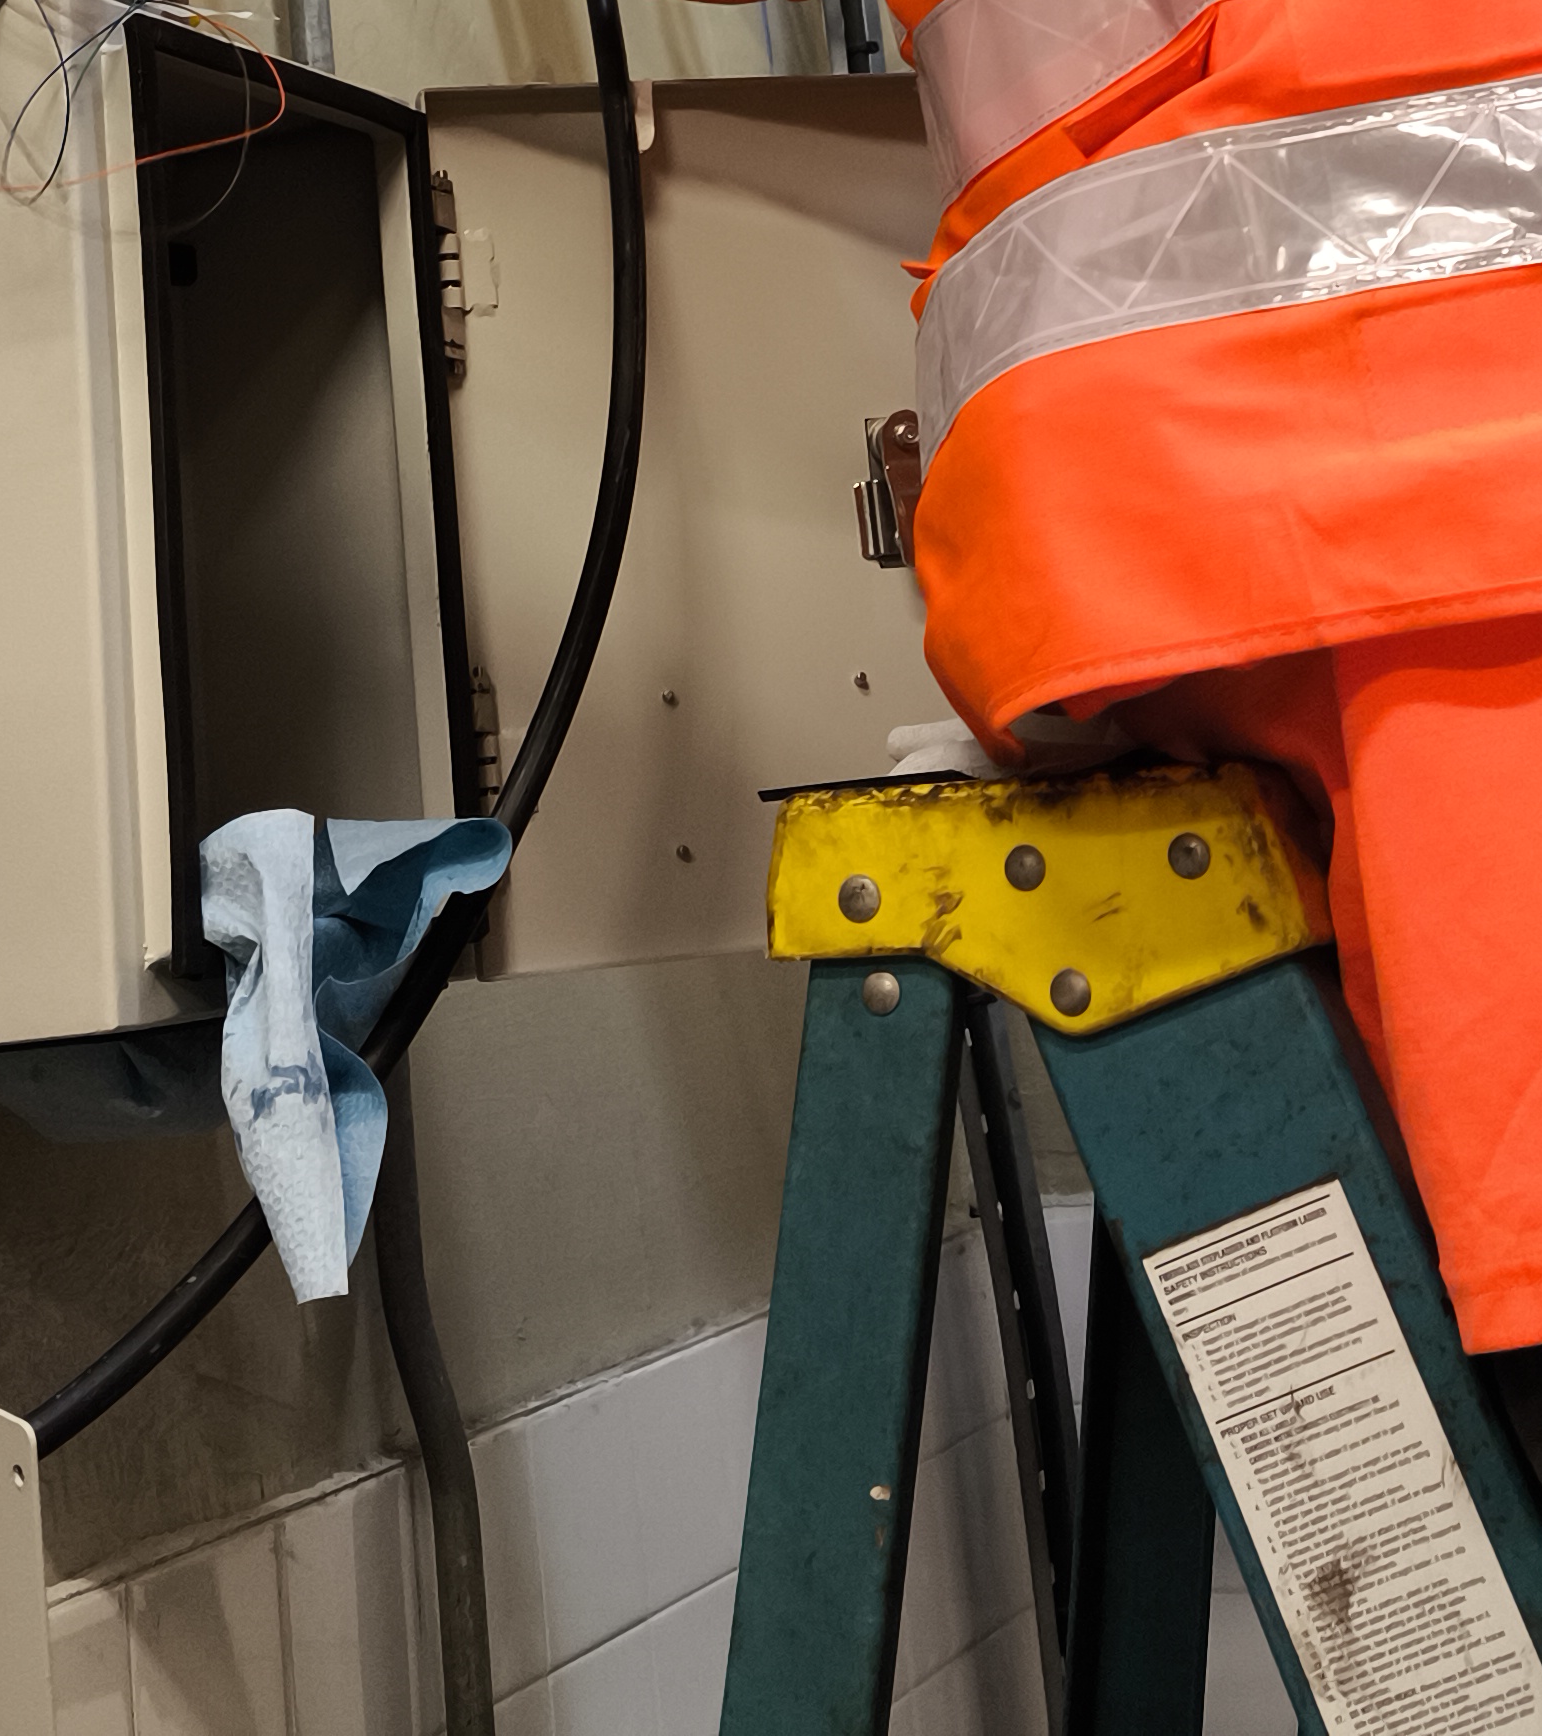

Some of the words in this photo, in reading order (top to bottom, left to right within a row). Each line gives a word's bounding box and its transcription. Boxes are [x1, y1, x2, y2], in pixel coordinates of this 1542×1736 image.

[1163, 1273, 1199, 1296] SAFETY
[1199, 1245, 1268, 1281] INSTRUCTIONS
[1220, 1417, 1259, 1440] PROPER
